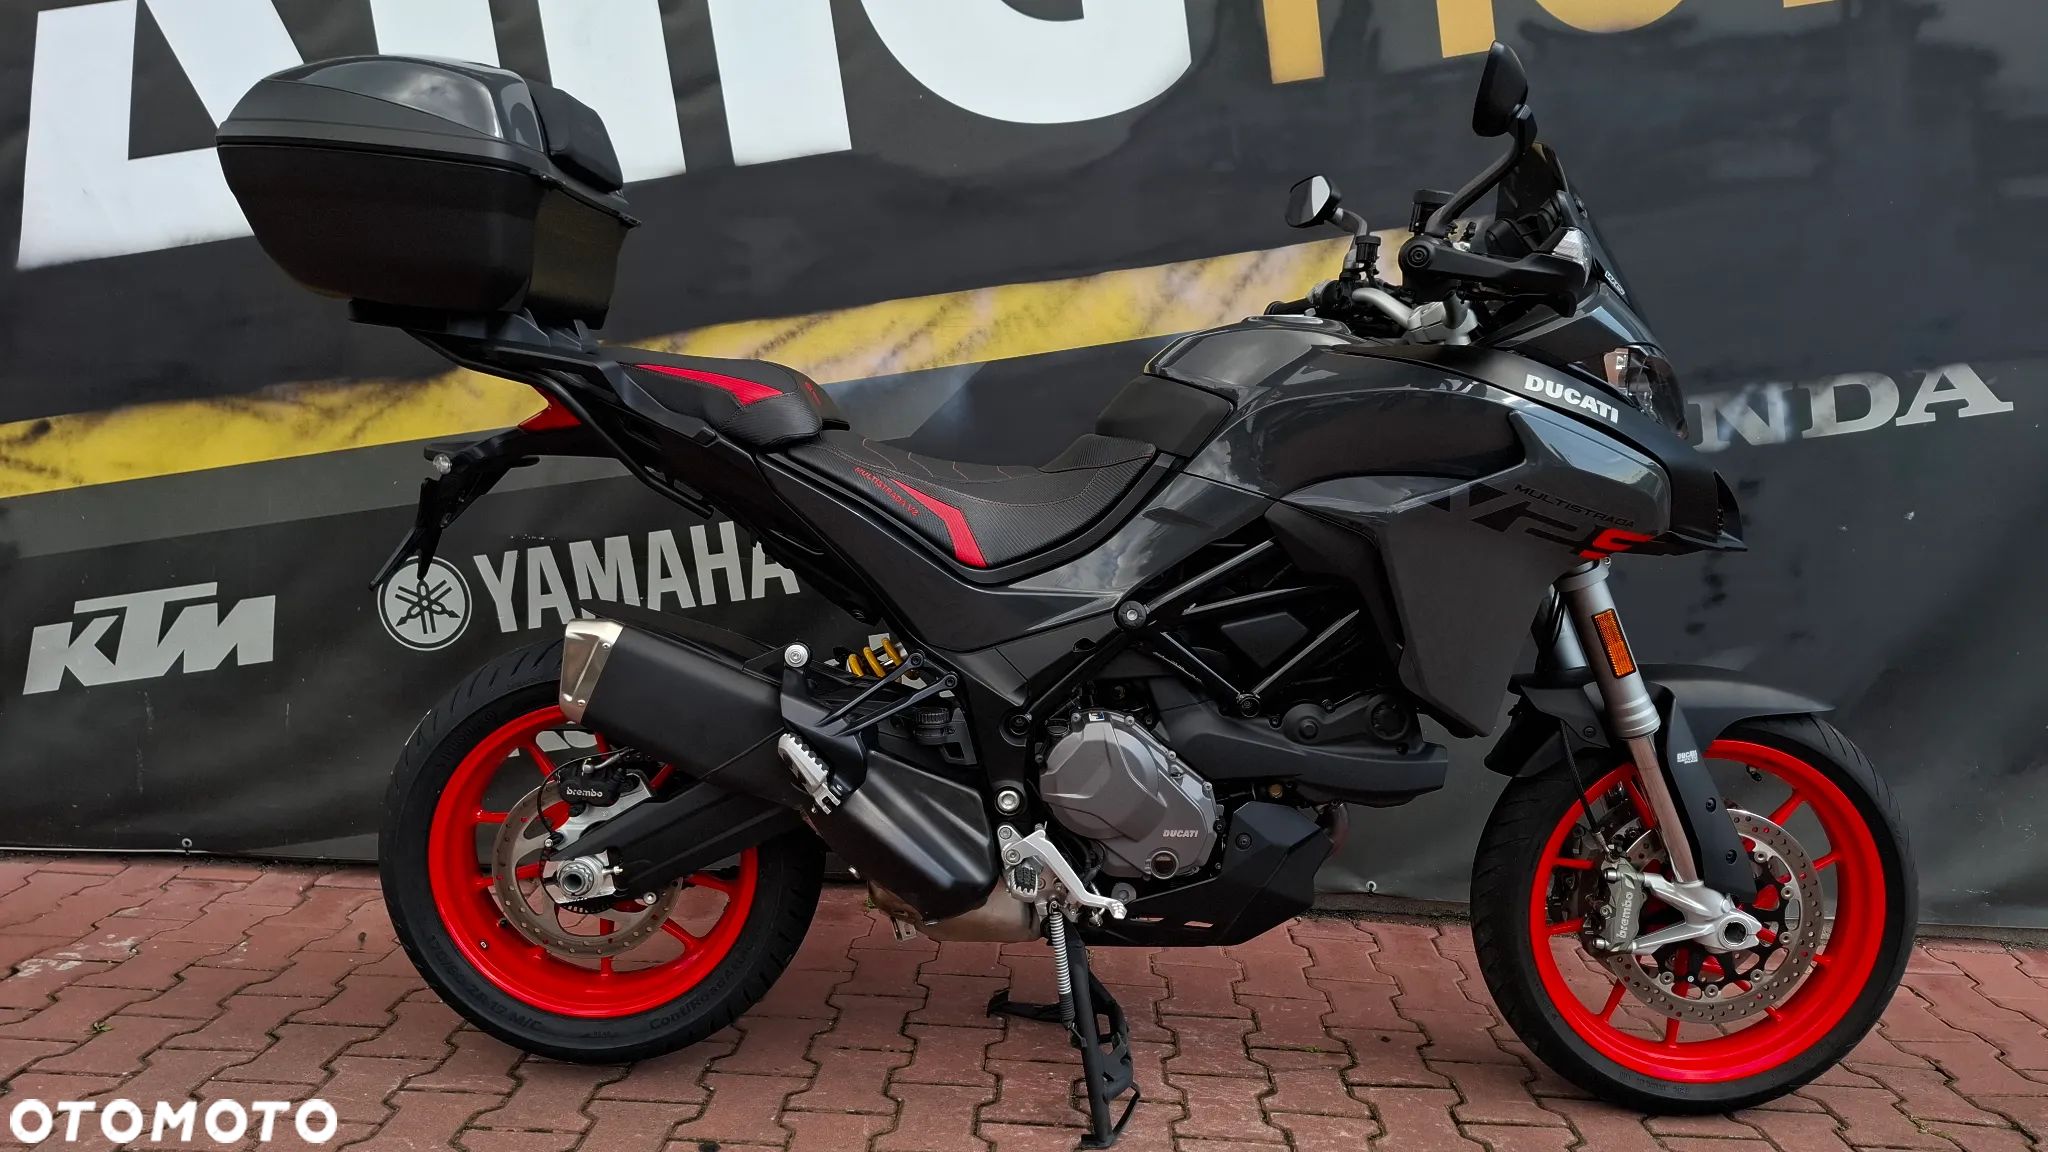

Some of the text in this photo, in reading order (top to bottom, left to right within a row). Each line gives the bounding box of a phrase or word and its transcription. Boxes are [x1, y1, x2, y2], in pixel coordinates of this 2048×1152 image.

[1524, 374, 1619, 424] DUCATI
[1687, 363, 2014, 452] NDA
[1514, 484, 1635, 528] MULTISTRADA
[473, 521, 800, 632] YAMAHA
[23, 582, 276, 695] KTM
[566, 788, 603, 798] brembo
[1162, 829, 1199, 838] DUCATI
[1616, 891, 1634, 939] brembo
